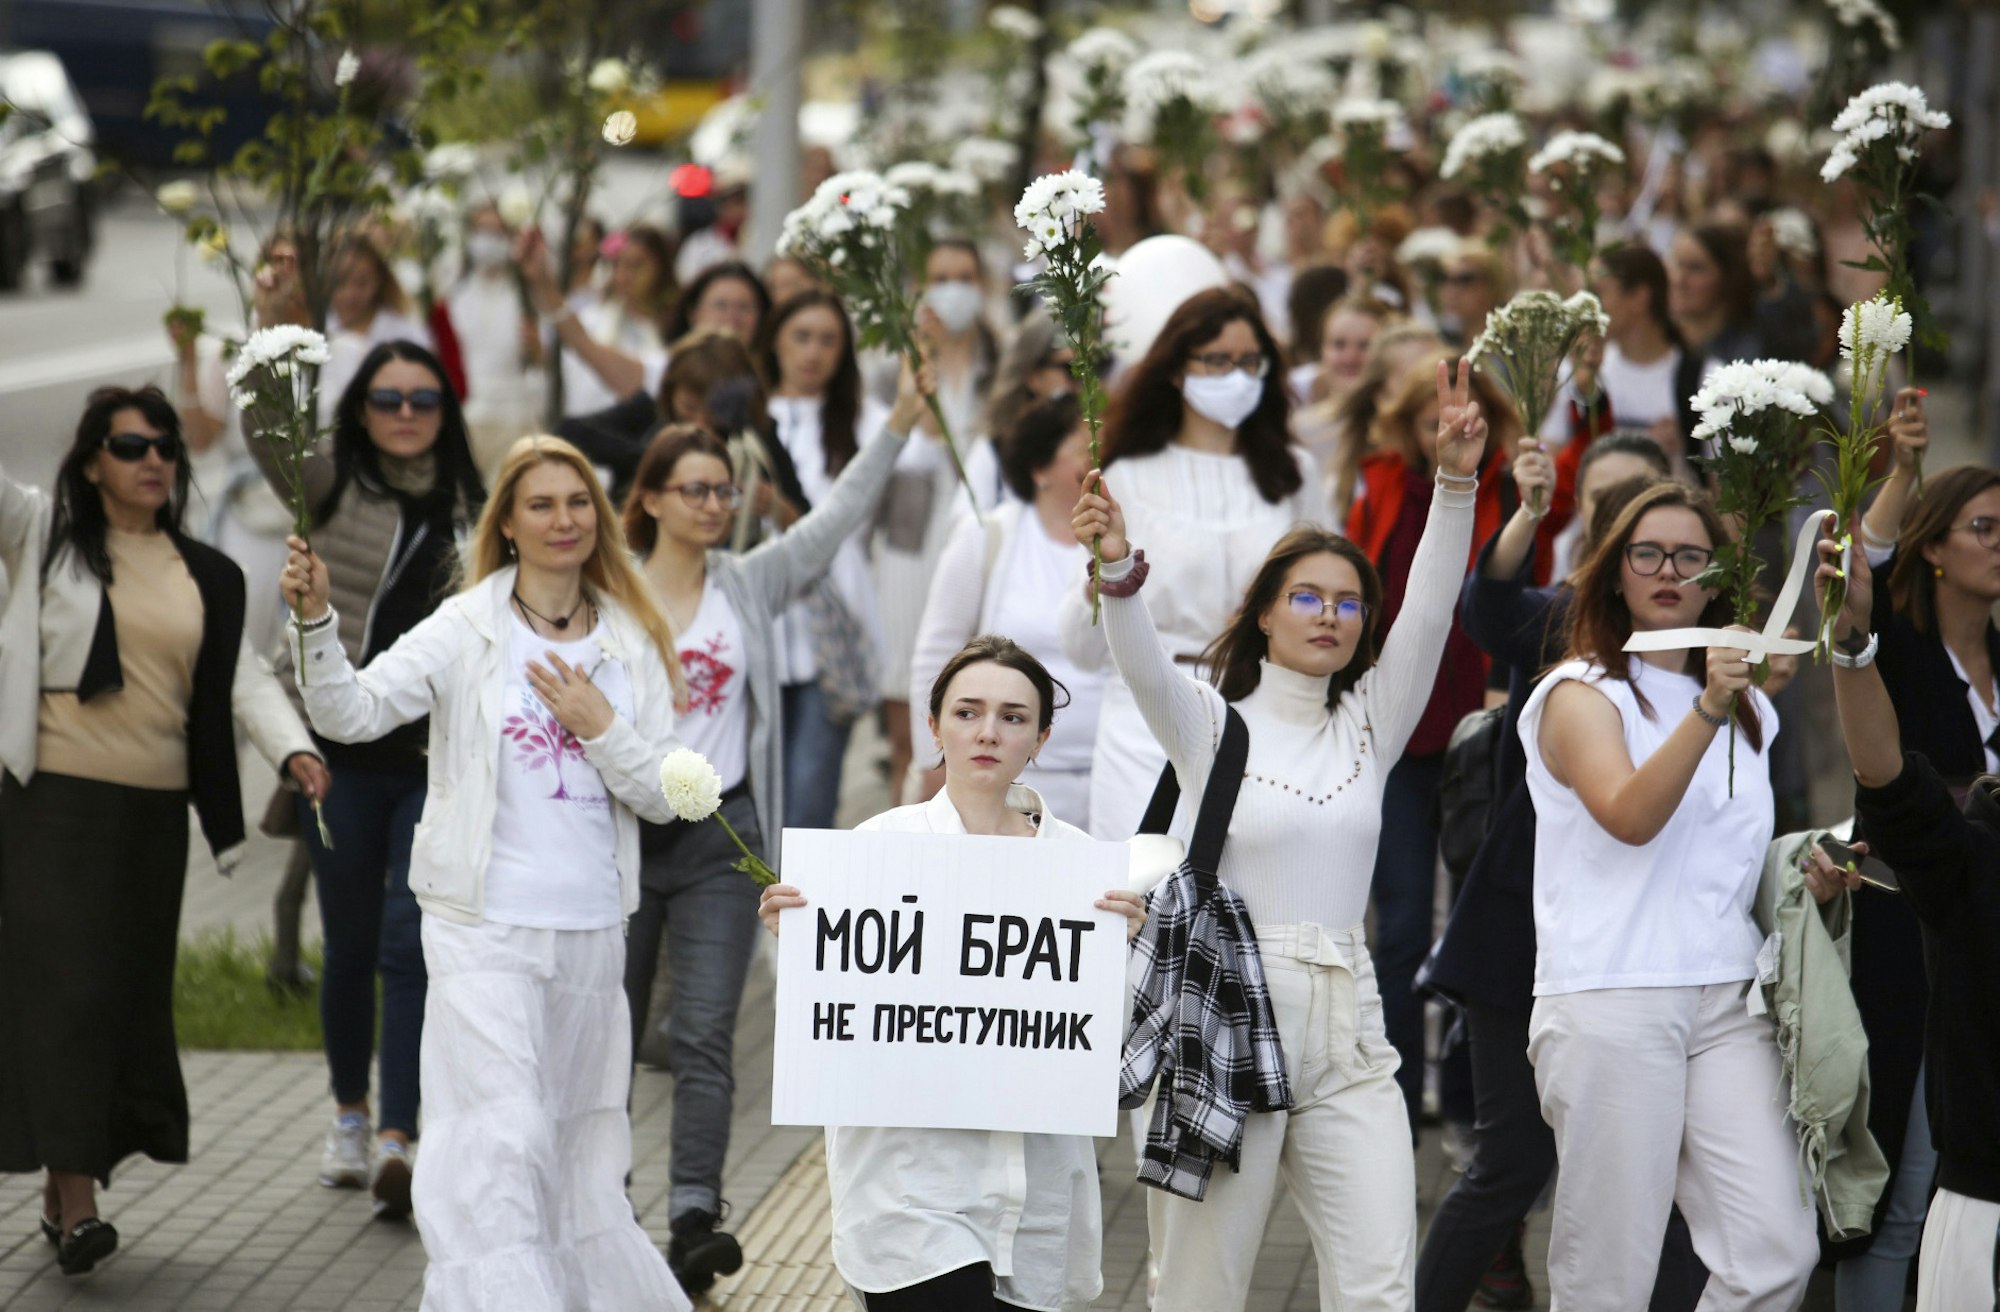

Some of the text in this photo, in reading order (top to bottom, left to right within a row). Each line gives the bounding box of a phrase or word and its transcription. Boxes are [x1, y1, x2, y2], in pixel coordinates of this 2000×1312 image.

[815, 895, 1096, 983] МОЙ БРАТ
[813, 1002, 1094, 1051] НЕ ПРЕСТУПНИК
